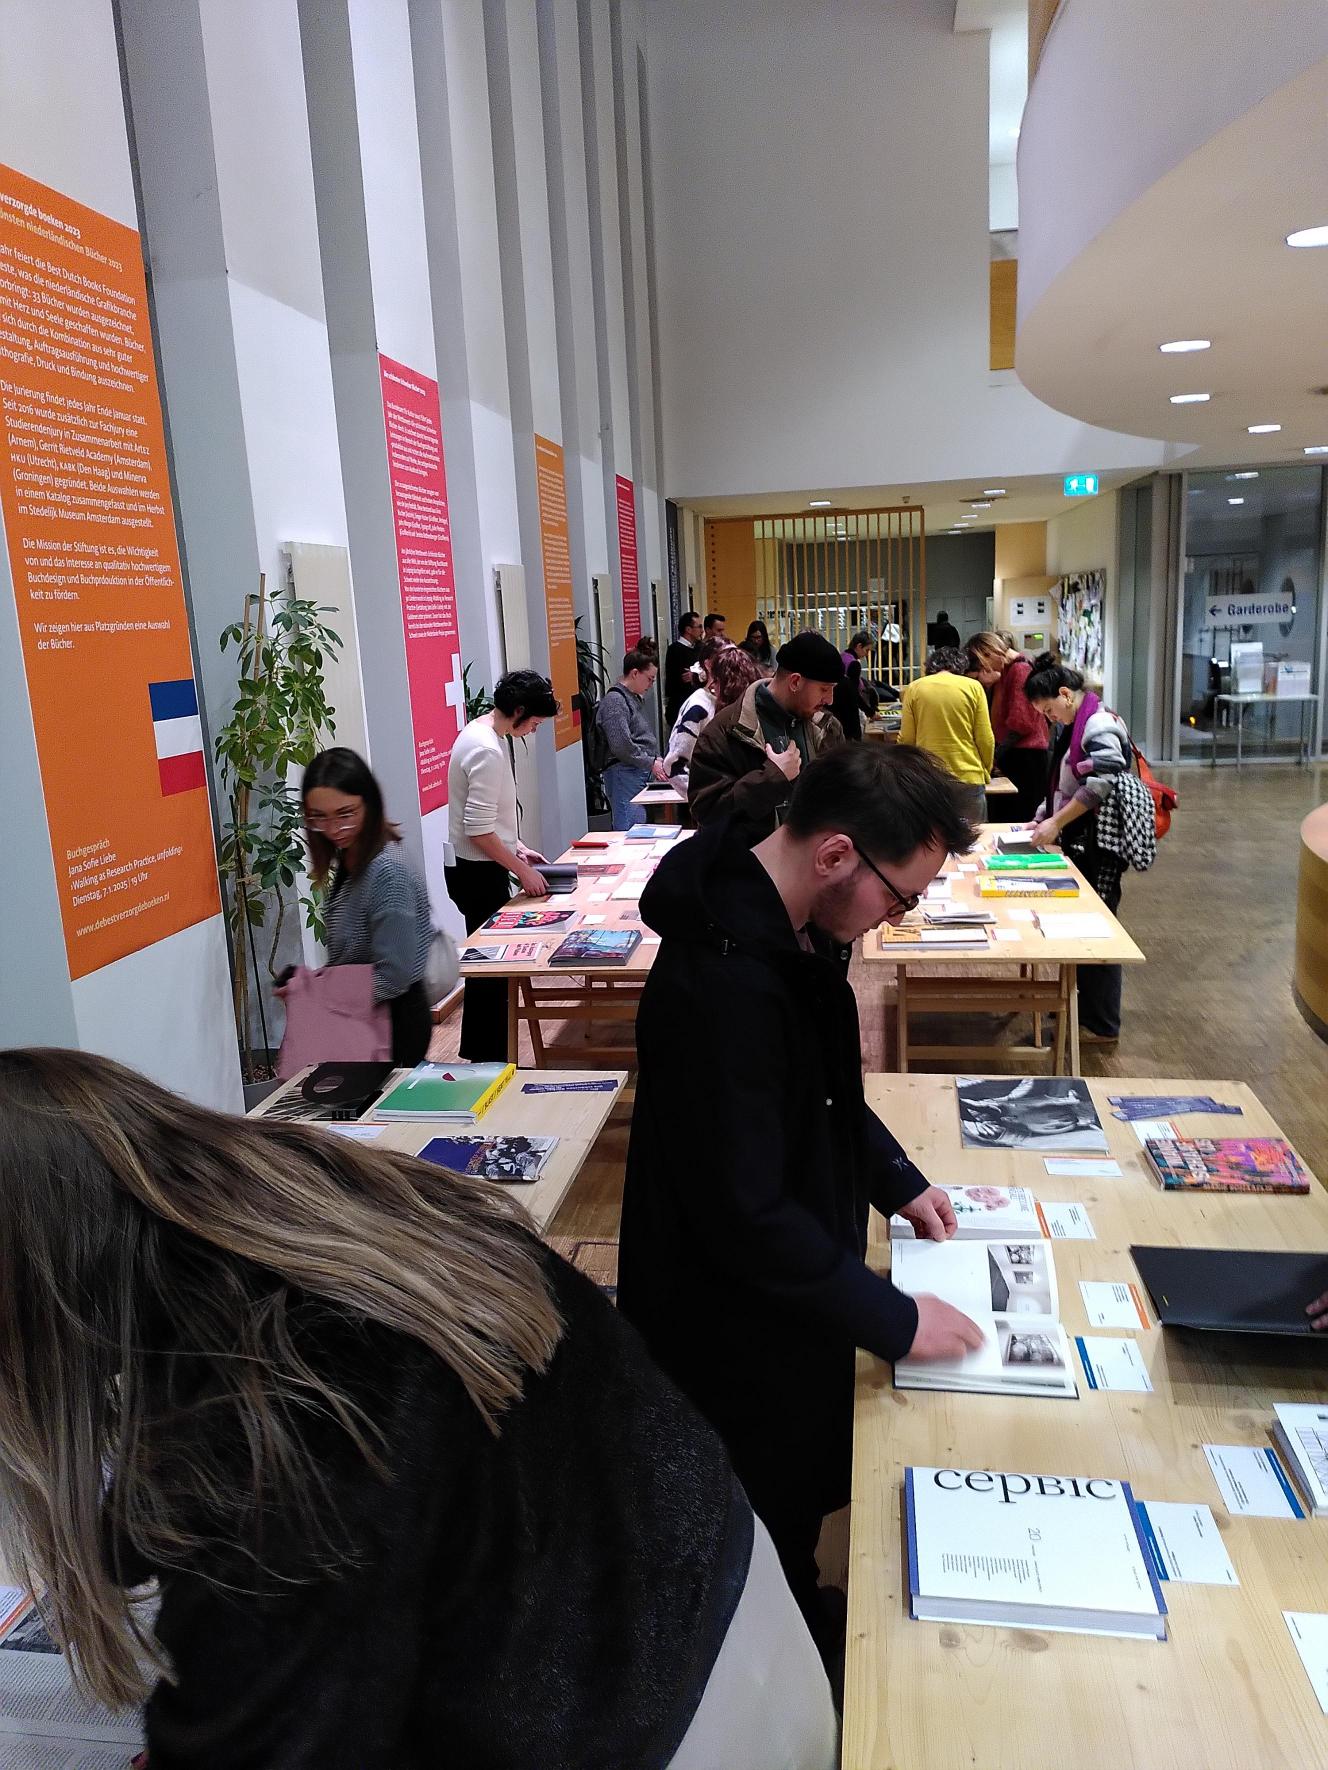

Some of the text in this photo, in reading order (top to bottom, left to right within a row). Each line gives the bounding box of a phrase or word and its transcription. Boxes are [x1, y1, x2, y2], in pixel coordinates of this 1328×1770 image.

[38, 208, 64, 228] boeken
[65, 225, 81, 239] 2023
[26, 221, 84, 254] niederländischen
[85, 247, 107, 263] Bücher
[108, 258, 122, 272] 2023
[0, 244, 135, 305] ahr feiert die Best Dutch Books Foundation
[0, 262, 137, 320] este, was die niederländische Grafikbranche
[0, 280, 30, 297] orbringt:
[32, 291, 41, 303] 33
[42, 293, 65, 309] Bücher
[66, 305, 90, 319] wurden
[13, 299, 30, 314] Herz
[31, 308, 45, 318] und
[46, 311, 64, 325] Seele
[65, 319, 99, 337] geschaffen
[2, 313, 132, 363] sich durch die Kombination aus sehr guter
[0, 331, 149, 383] estaltung, Auftragsausführung und hochwertiger
[36, 357, 56, 371] Druck
[57, 364, 69, 375] und
[70, 368, 97, 384] Bindung
[97, 376, 135, 393] auszeichnen.
[1, 381, 147, 425] Die Jurierung findet jedes Jahr Ende Januar statt.
[3, 398, 138, 438] Seit 2016 wurde zusätzlich zur Fachjury eine
[6, 416, 63, 440] Studierendenjury
[71, 431, 122, 449] Zusammenarbeit
[123, 442, 133, 451] mit
[11, 454, 25, 463] HKU
[27, 454, 59, 471] (Utrecht),
[60, 463, 76, 471] KABK
[77, 463, 92, 474] (Den
[93, 468, 110, 479] Haag)
[124, 473, 147, 483] Minerva
[39, 441, 58, 452] Gerrit
[59, 445, 85, 457] Rietveld
[86, 449, 113, 465] Academy
[13, 468, 53, 485] (Groningen)
[55, 477, 88, 490] gegründet.
[89, 481, 106, 492] Beide
[139, 490, 160, 499] werden
[16, 486, 165, 515] in einem Katalog zusammengefasst und im Herbst
[18, 503, 154, 528] im Stedelijk Museum Amsterdam ausgestellt.
[23, 538, 35, 549] Die
[37, 539, 60, 550] Mission
[63, 541, 72, 550] der
[74, 542, 99, 556] Stiftung
[108, 547, 116, 555] es,
[117, 545, 126, 554] die
[127, 546, 158, 559] Wichtigkeit
[28, 572, 66, 585] Buchdesign
[67, 574, 79, 583] und
[135, 577, 144, 585] der
[145, 576, 174, 586] Öffentlich-
[40, 557, 52, 566] und
[54, 557, 65, 567] das
[66, 558, 93, 568] Interesse
[103, 561, 130, 571] qualitativ
[132, 562, 171, 574] hochwertigem
[30, 590, 43, 599] keit
[54, 590, 80, 600] fördern.
[1228, 603, 1288, 615] Garderobe
[34, 621, 170, 634] Wir zeigen hier aus Platzgründen eine Auswahl
[38, 639, 75, 649] der Bücher.
[66, 838, 110, 859] Buchgespräch
[68, 852, 116, 877] Jana Sofie Liebe
[106, 862, 133, 878] Research
[134, 855, 156, 869] Practice,
[72, 889, 102, 906] Dienstag,
[131, 878, 138, 886] 19
[138, 872, 148, 882] Uhr
[933, 1469, 1117, 1504] сервіс
